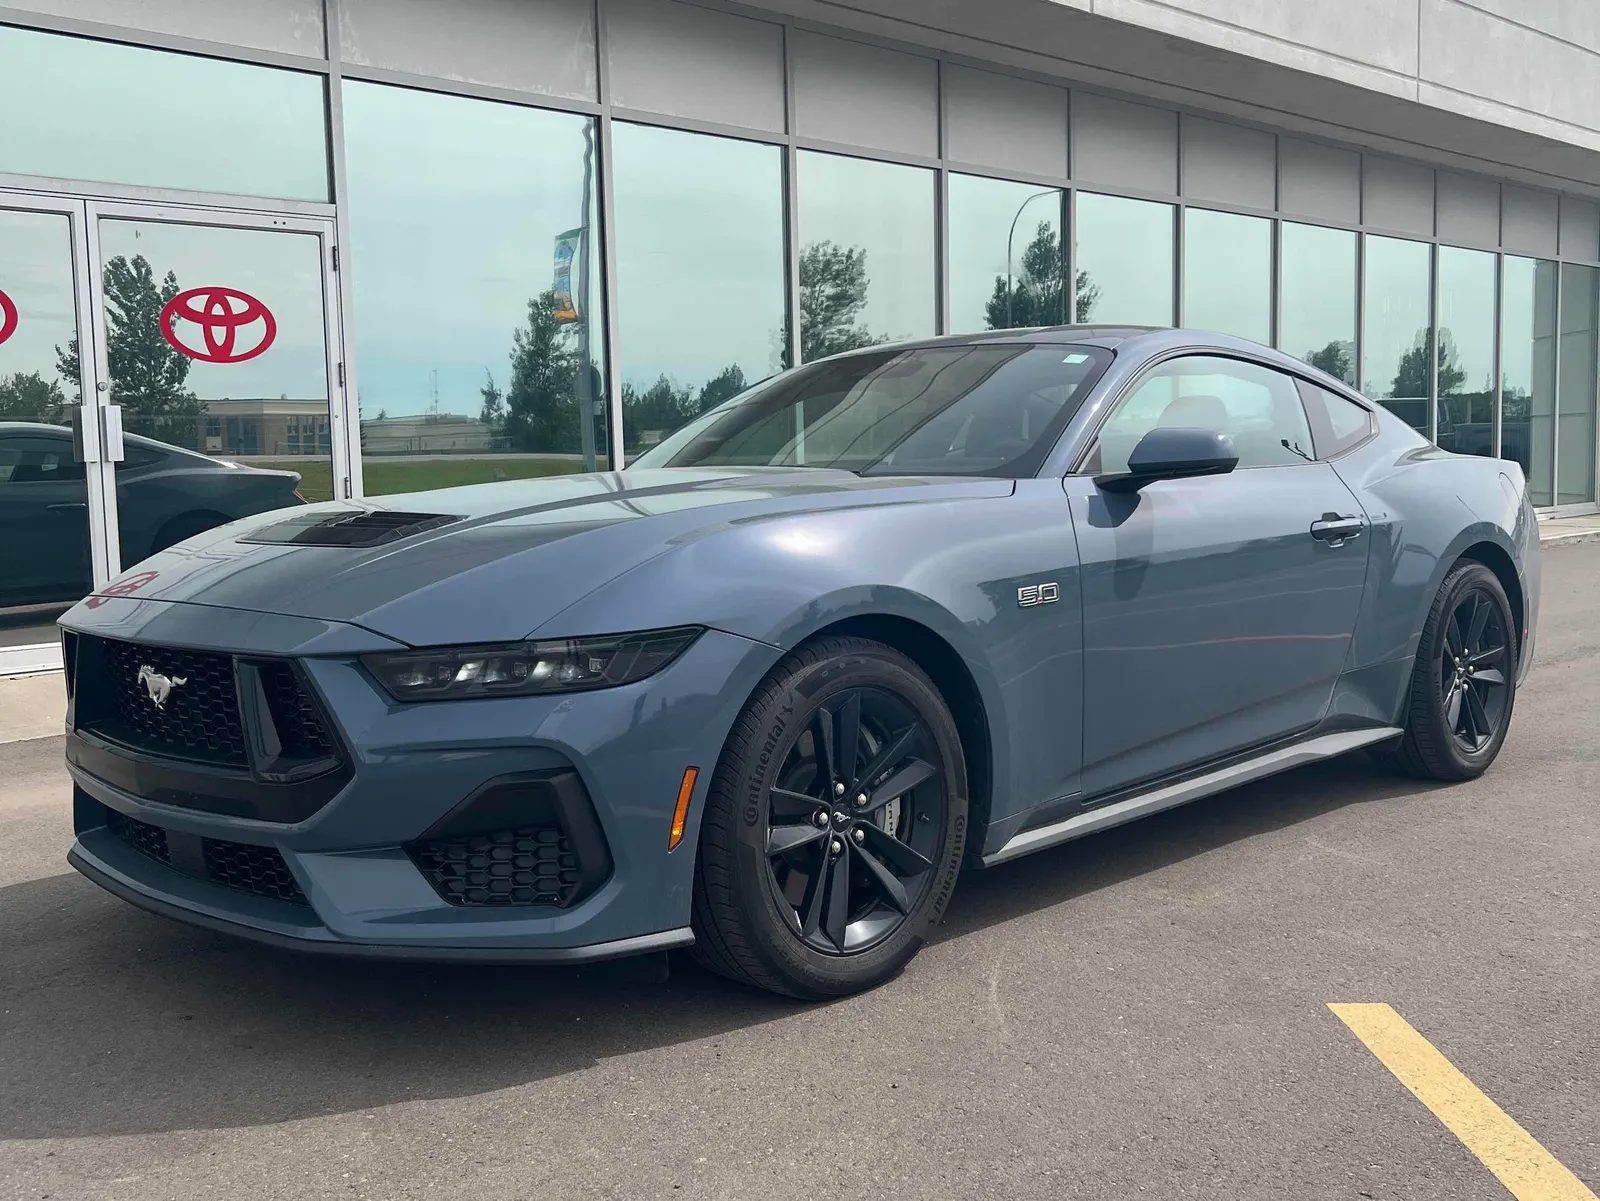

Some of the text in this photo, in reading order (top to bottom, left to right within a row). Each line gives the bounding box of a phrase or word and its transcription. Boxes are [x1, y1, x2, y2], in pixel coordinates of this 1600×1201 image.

[1017, 582, 1060, 607] 5.0
[743, 714, 787, 827] Continental
[933, 813, 967, 914] Continental
